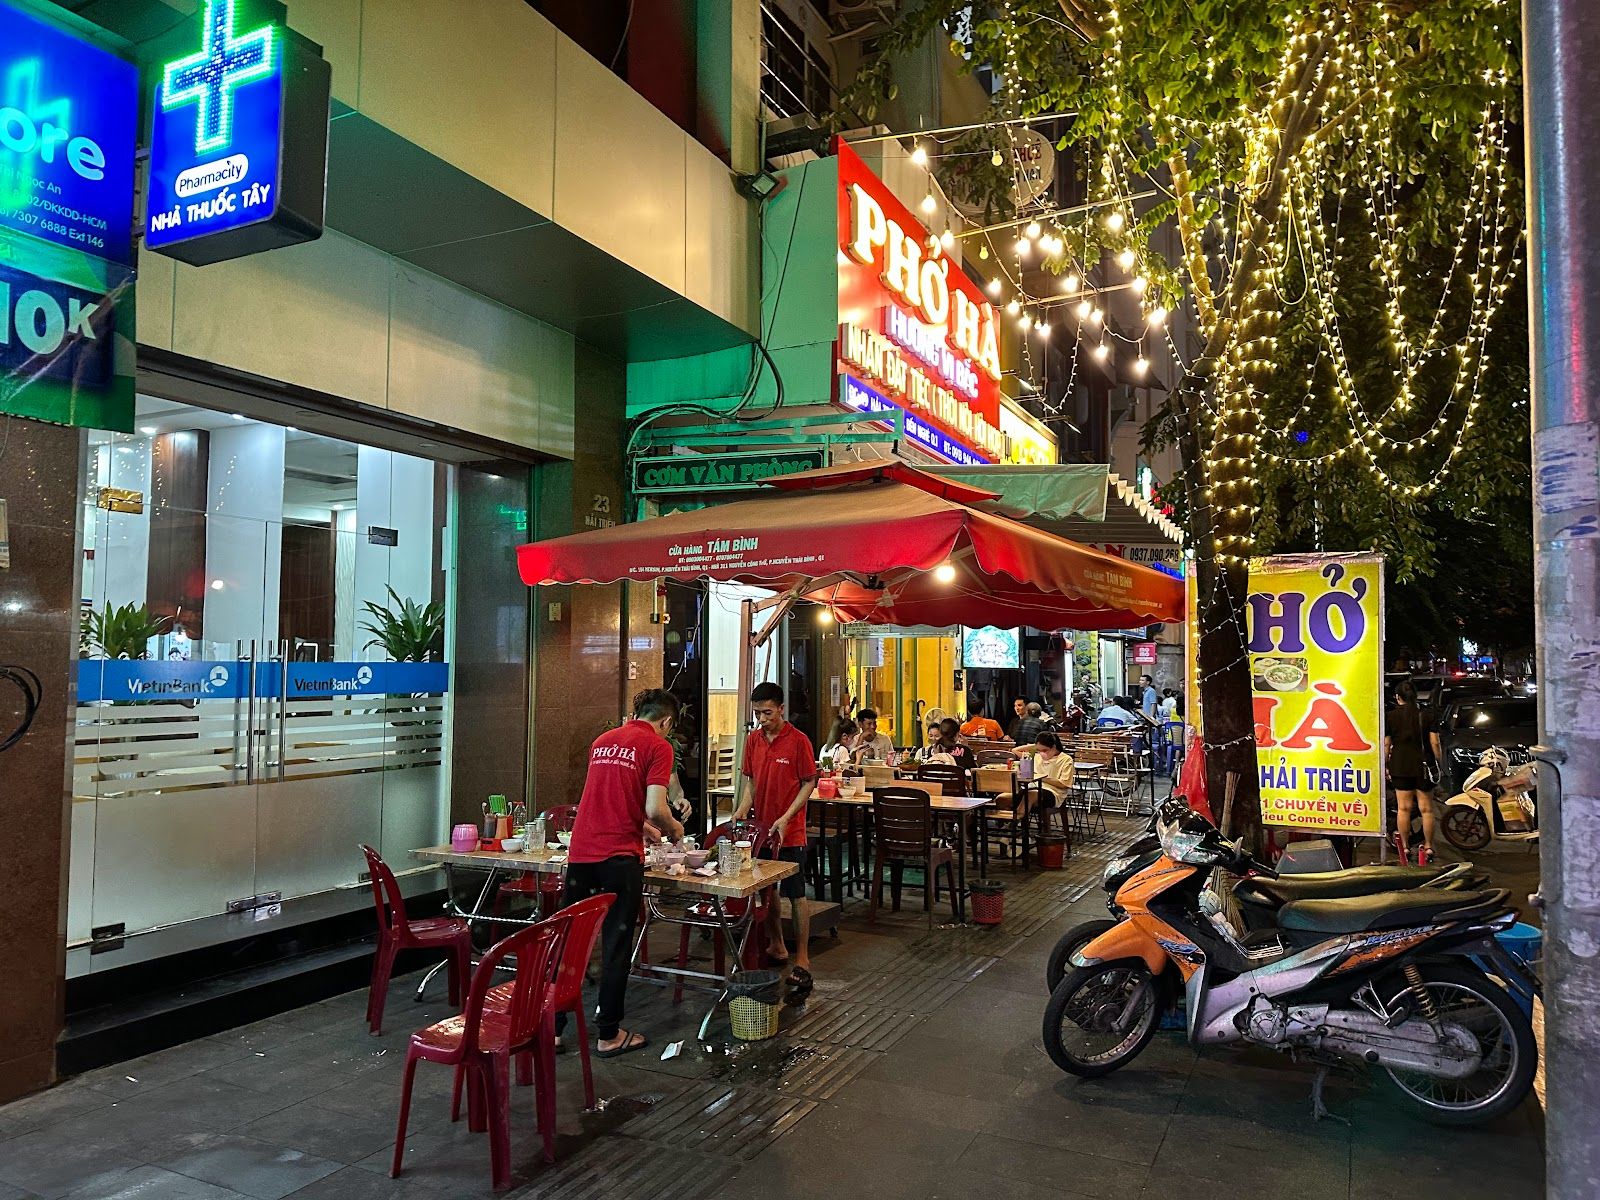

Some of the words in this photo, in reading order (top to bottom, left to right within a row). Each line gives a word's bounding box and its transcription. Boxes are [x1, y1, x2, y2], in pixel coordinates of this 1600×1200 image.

[180, 161, 242, 192] Pharmacity
[47, 182, 61, 194] An
[187, 187, 236, 222] THUỐC
[242, 183, 270, 208] TÂY
[13, 208, 38, 224] 7307
[40, 219, 67, 235] 6888
[87, 233, 104, 248] 146
[848, 183, 949, 325] PHỞ
[952, 288, 1002, 382] HÀ
[644, 465, 686, 486] CƠM
[690, 461, 735, 484] VĂN
[592, 494, 609, 513] 23
[683, 544, 703, 555] HÀNG
[706, 538, 731, 553] TÁM
[732, 536, 758, 551] BÌNH
[1249, 563, 1367, 654] HỞ
[128, 678, 210, 695] VietinBank
[295, 677, 358, 692] VietinBank
[592, 744, 619, 758] PHỞ
[617, 747, 636, 762] HÀ
[1261, 758, 1297, 790] HẢI
[1304, 758, 1371, 794] TRIỀU
[1275, 796, 1337, 813] CHUYỂN
[1288, 813, 1325, 824] Come
[1329, 816, 1361, 827] Here
